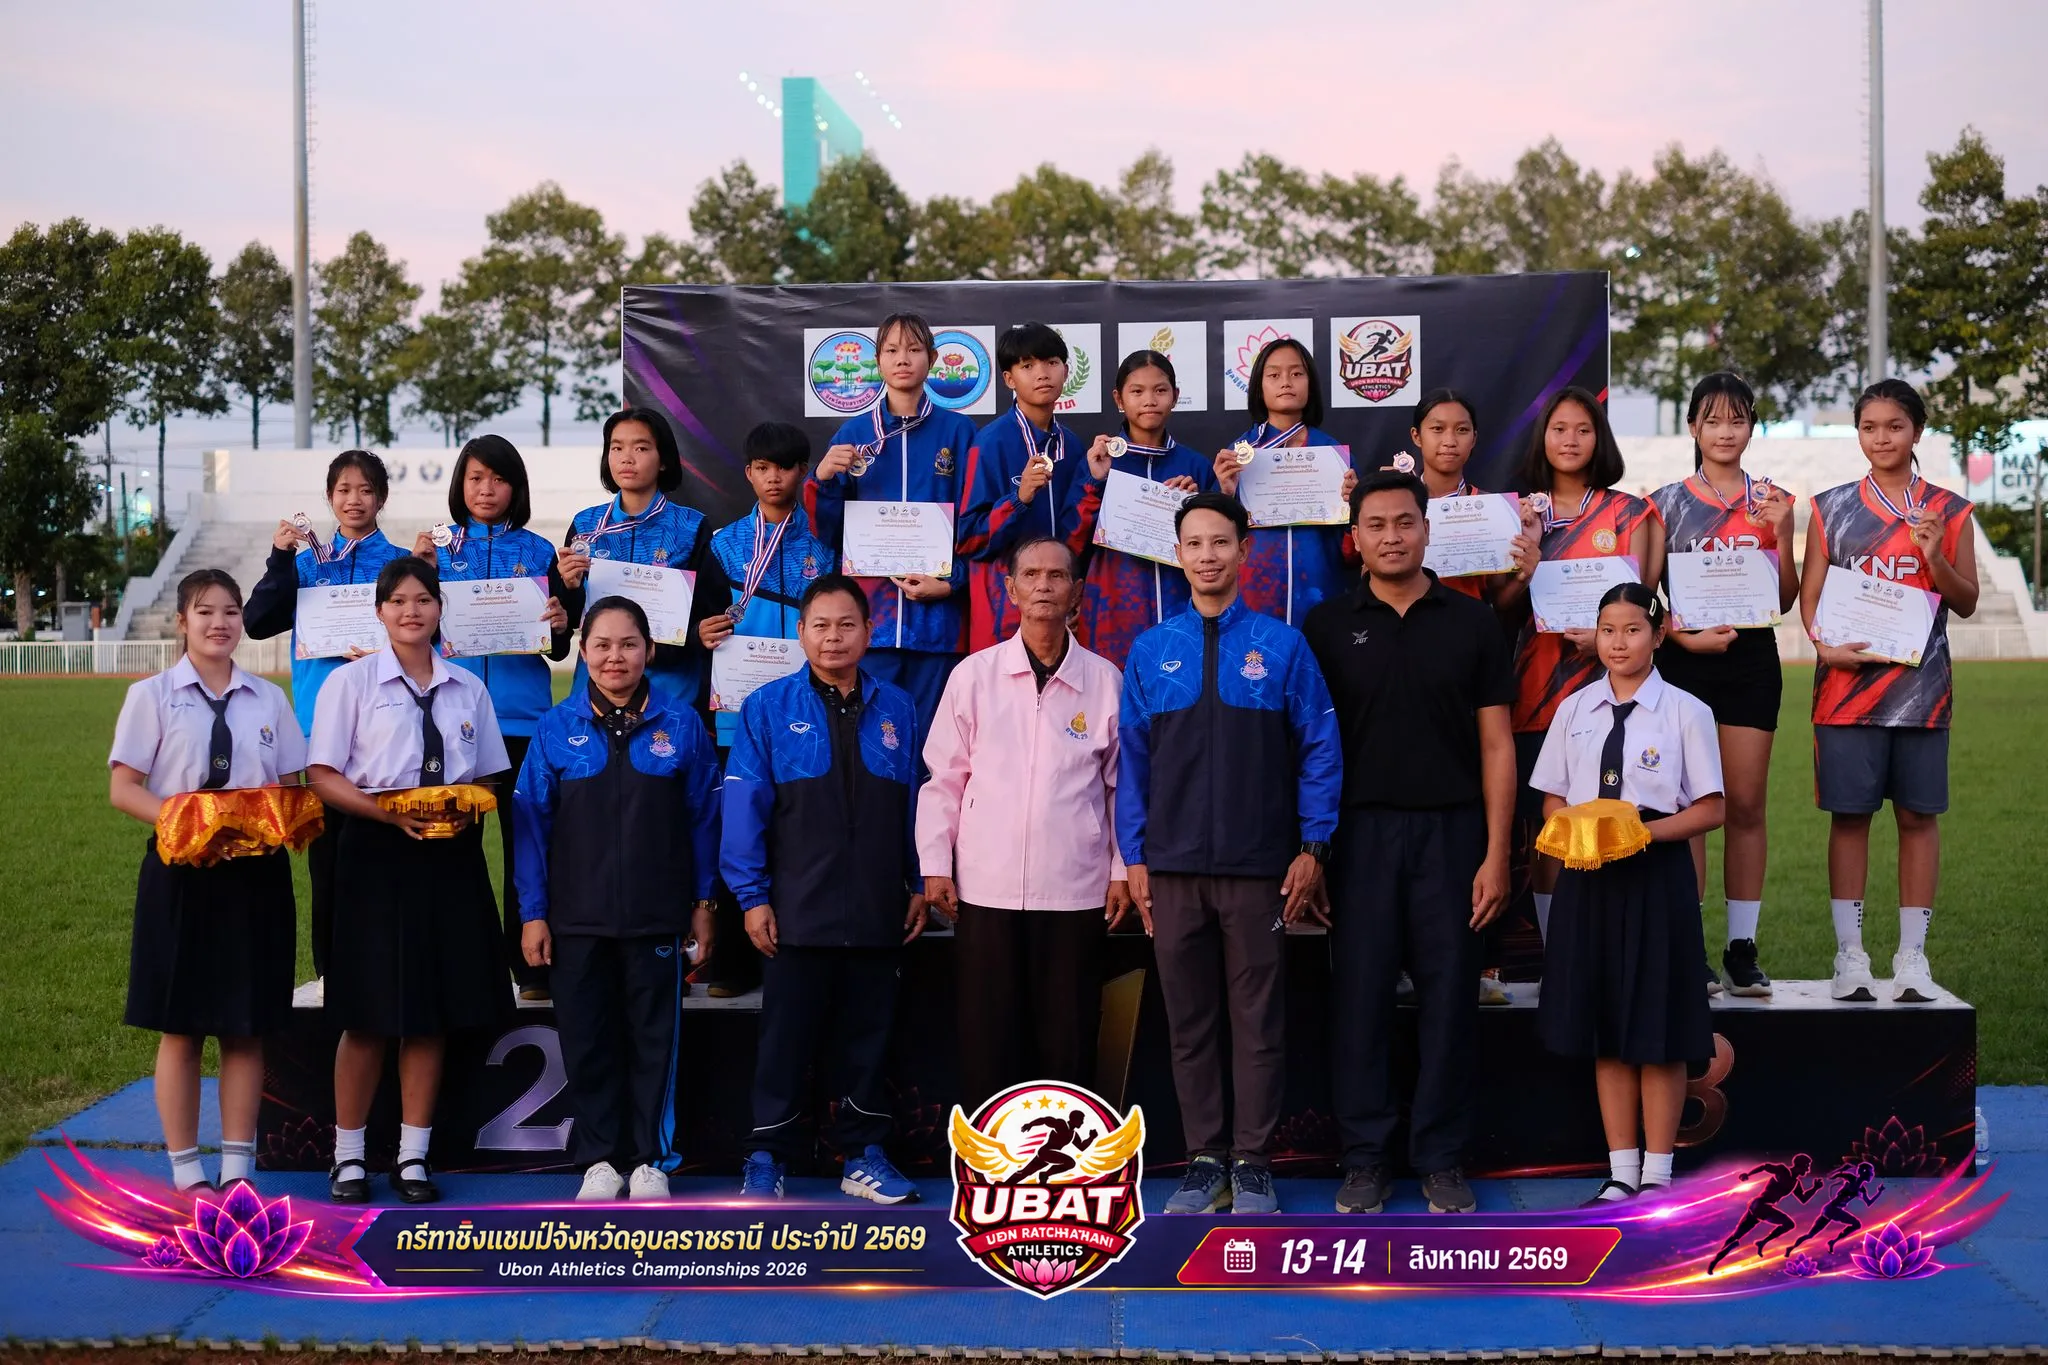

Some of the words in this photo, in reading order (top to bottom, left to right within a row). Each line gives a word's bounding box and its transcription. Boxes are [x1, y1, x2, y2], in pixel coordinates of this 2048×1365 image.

[1345, 362, 1407, 379] UBAT
[1849, 555, 1920, 580] KNP
[474, 1024, 574, 1152] 2
